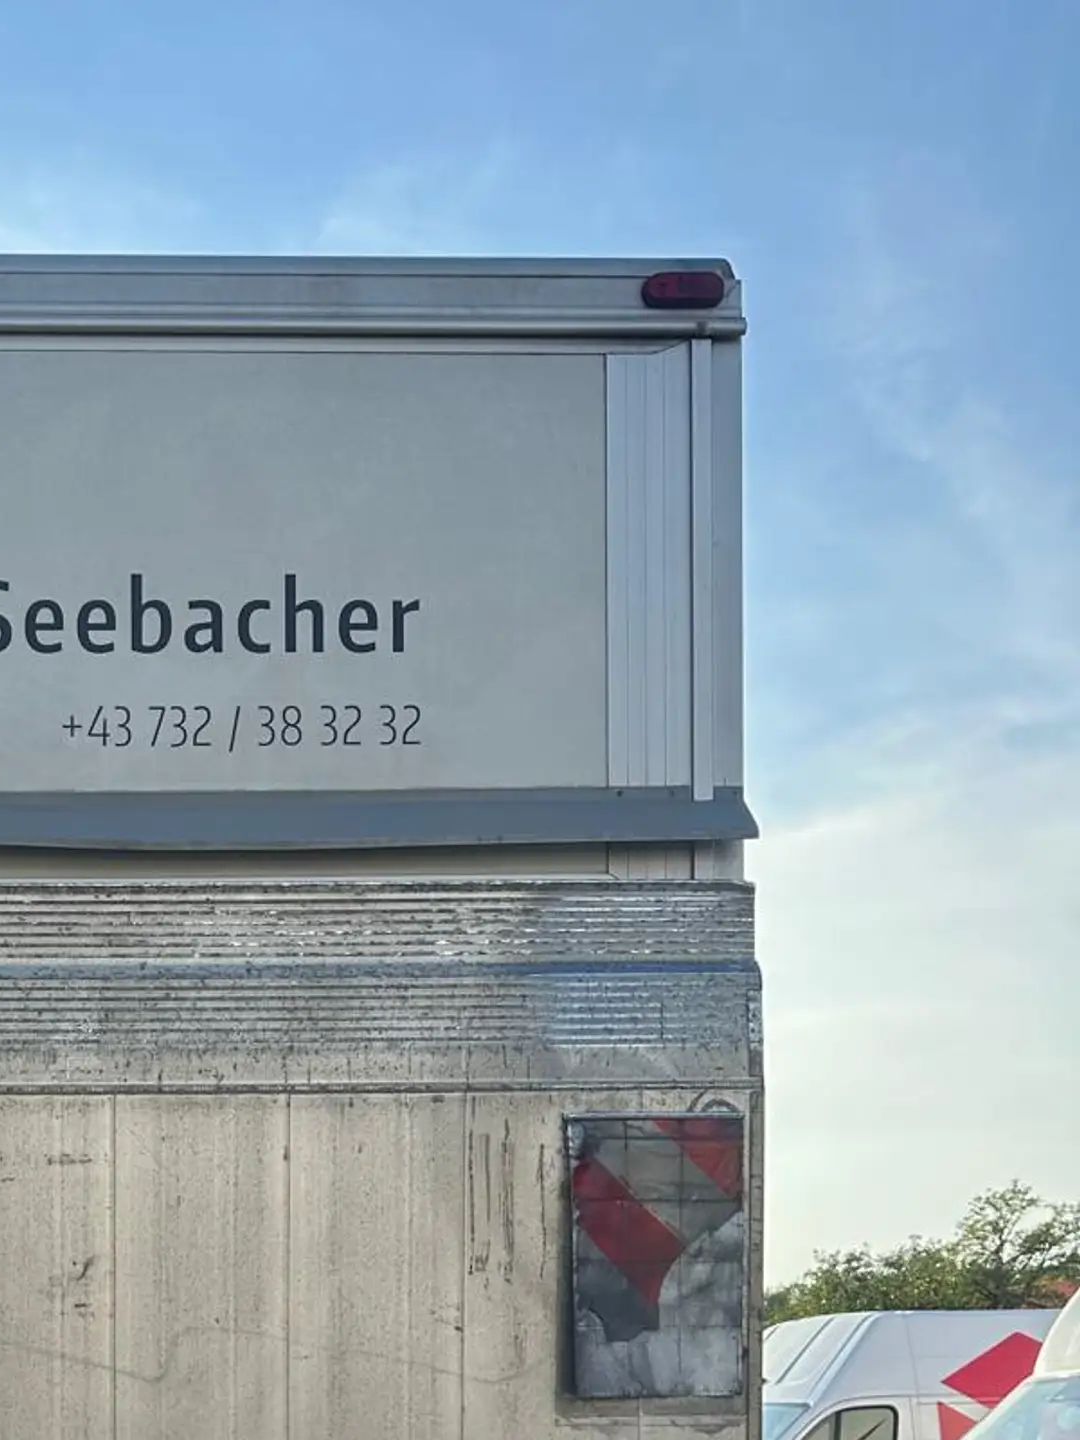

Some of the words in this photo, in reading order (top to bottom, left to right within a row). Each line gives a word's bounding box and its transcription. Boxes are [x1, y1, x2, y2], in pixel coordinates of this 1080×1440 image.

[62, 705, 132, 748] +43
[147, 705, 213, 748] 732
[228, 705, 241, 753] /
[257, 704, 302, 747] 38
[319, 704, 362, 747] 32
[379, 703, 422, 746] 32
